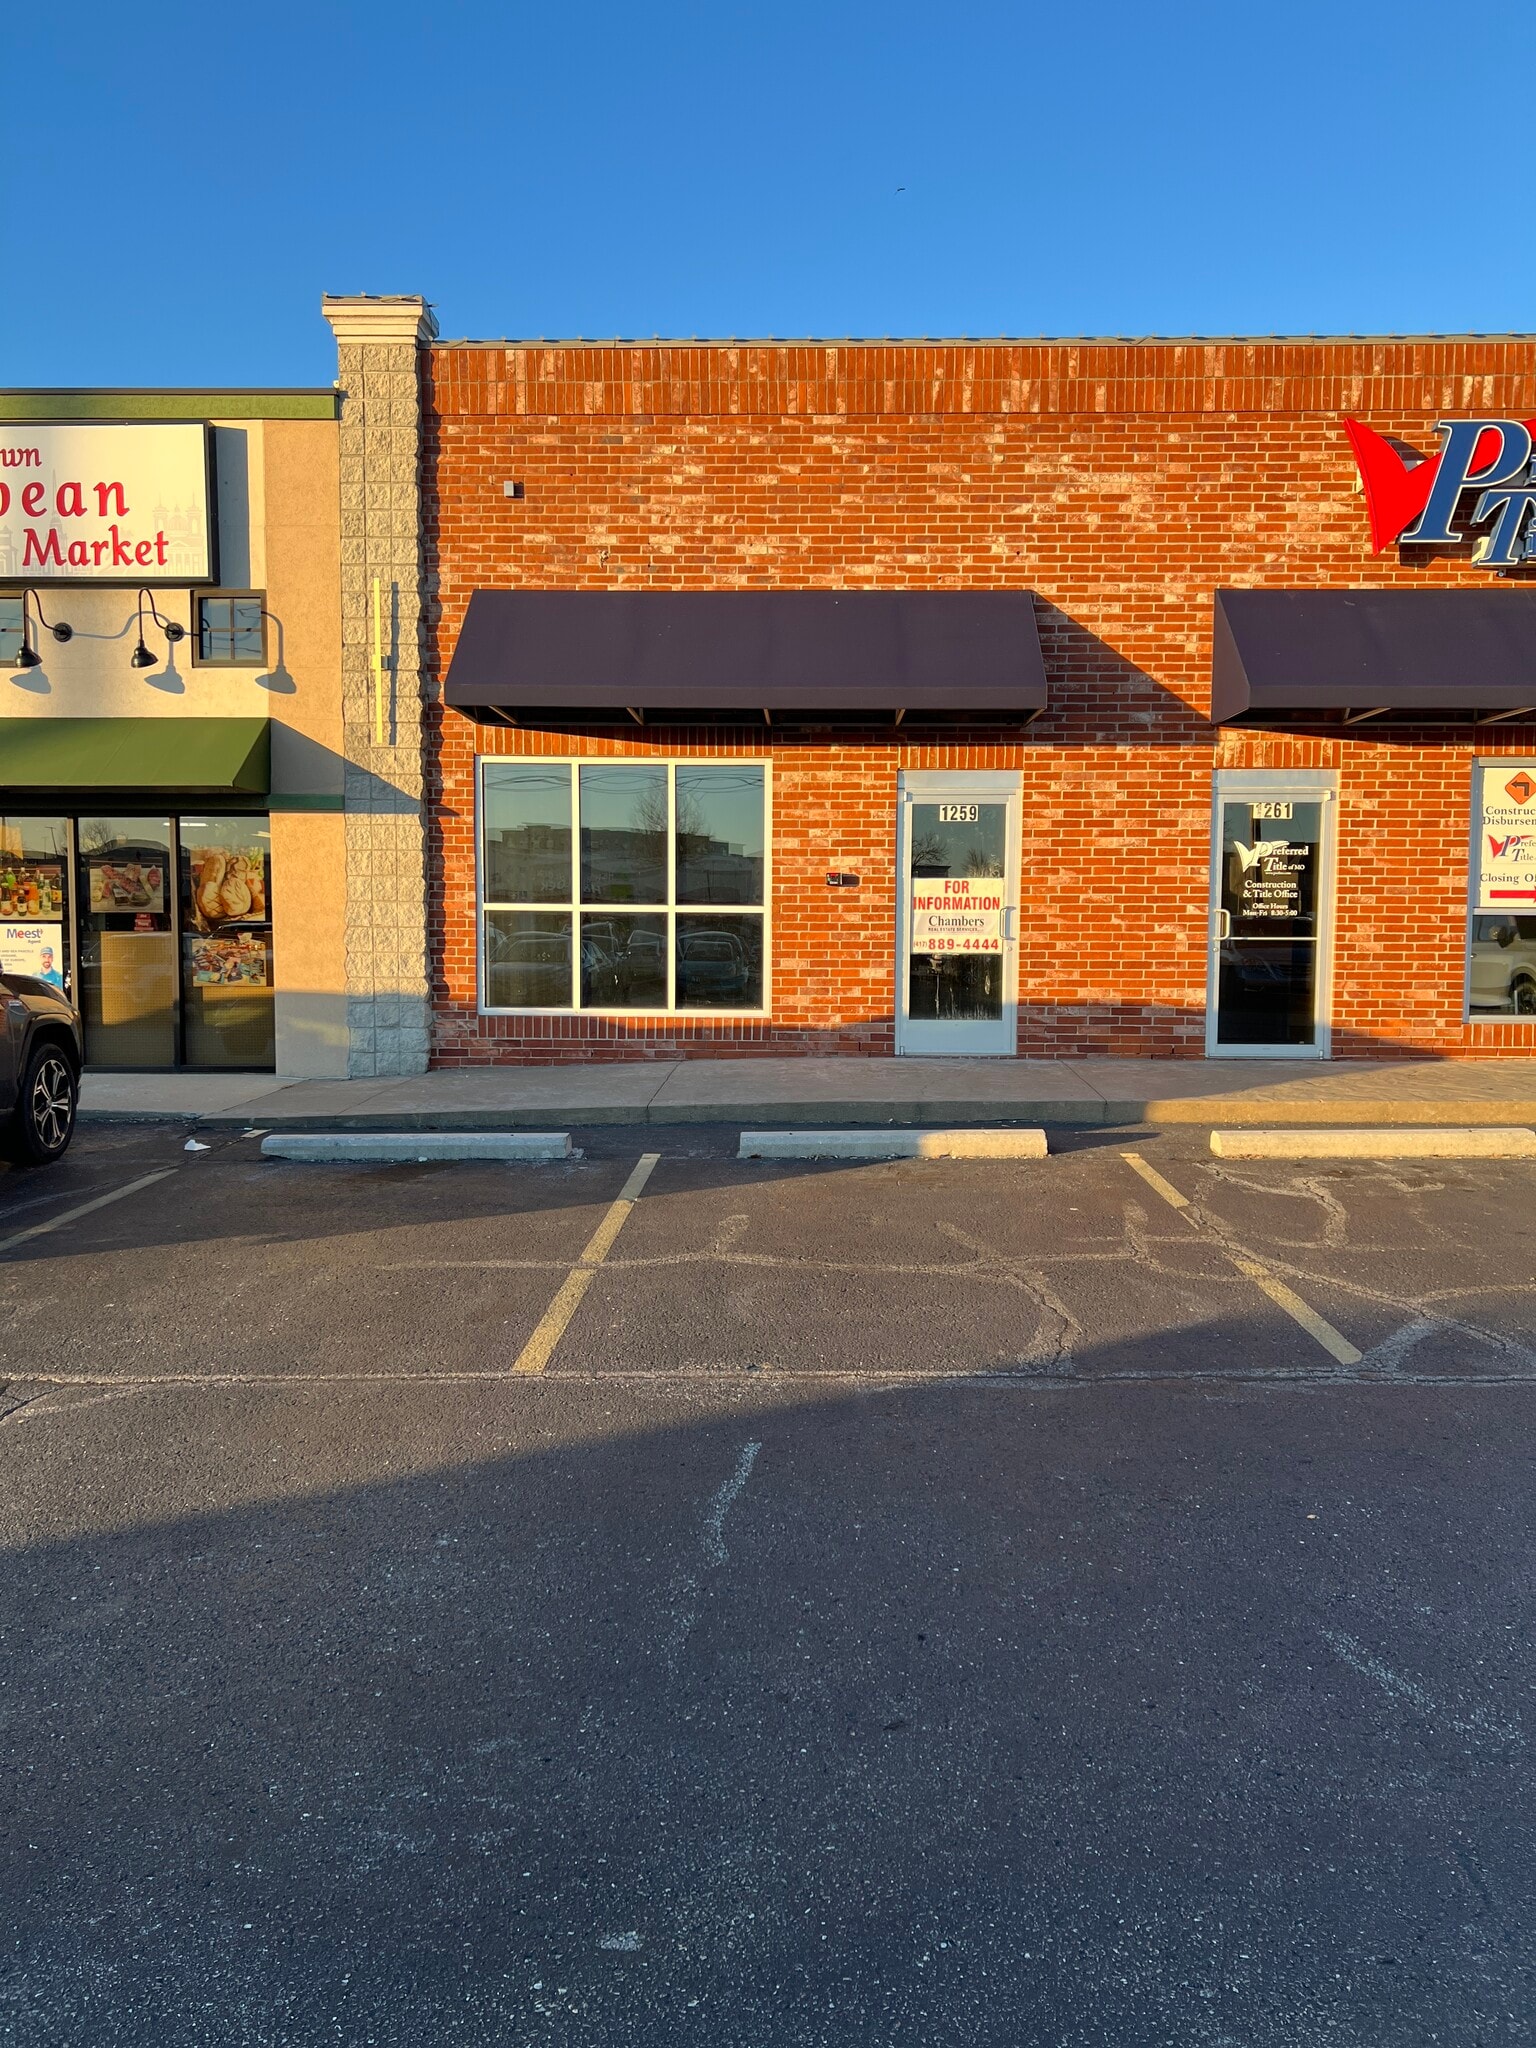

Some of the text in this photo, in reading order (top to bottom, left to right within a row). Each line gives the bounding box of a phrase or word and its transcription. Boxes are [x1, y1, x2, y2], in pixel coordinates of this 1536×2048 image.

[22, 524, 169, 566] Market
[942, 805, 977, 821] 1259
[1256, 802, 1290, 818] 1261
[1250, 841, 1309, 867] Preferred
[1512, 848, 1534, 862] Title
[1264, 857, 1287, 872] Title
[1244, 879, 1297, 889] Construction
[1480, 873, 1520, 885] Closing
[944, 880, 970, 894] FOR
[1242, 889, 1298, 898] & Title Office
[912, 896, 1000, 911] INFORMATION
[928, 915, 985, 927] Chambers
[6, 928, 42, 939] Meest
[913, 938, 999, 950] (417) 889-4444
